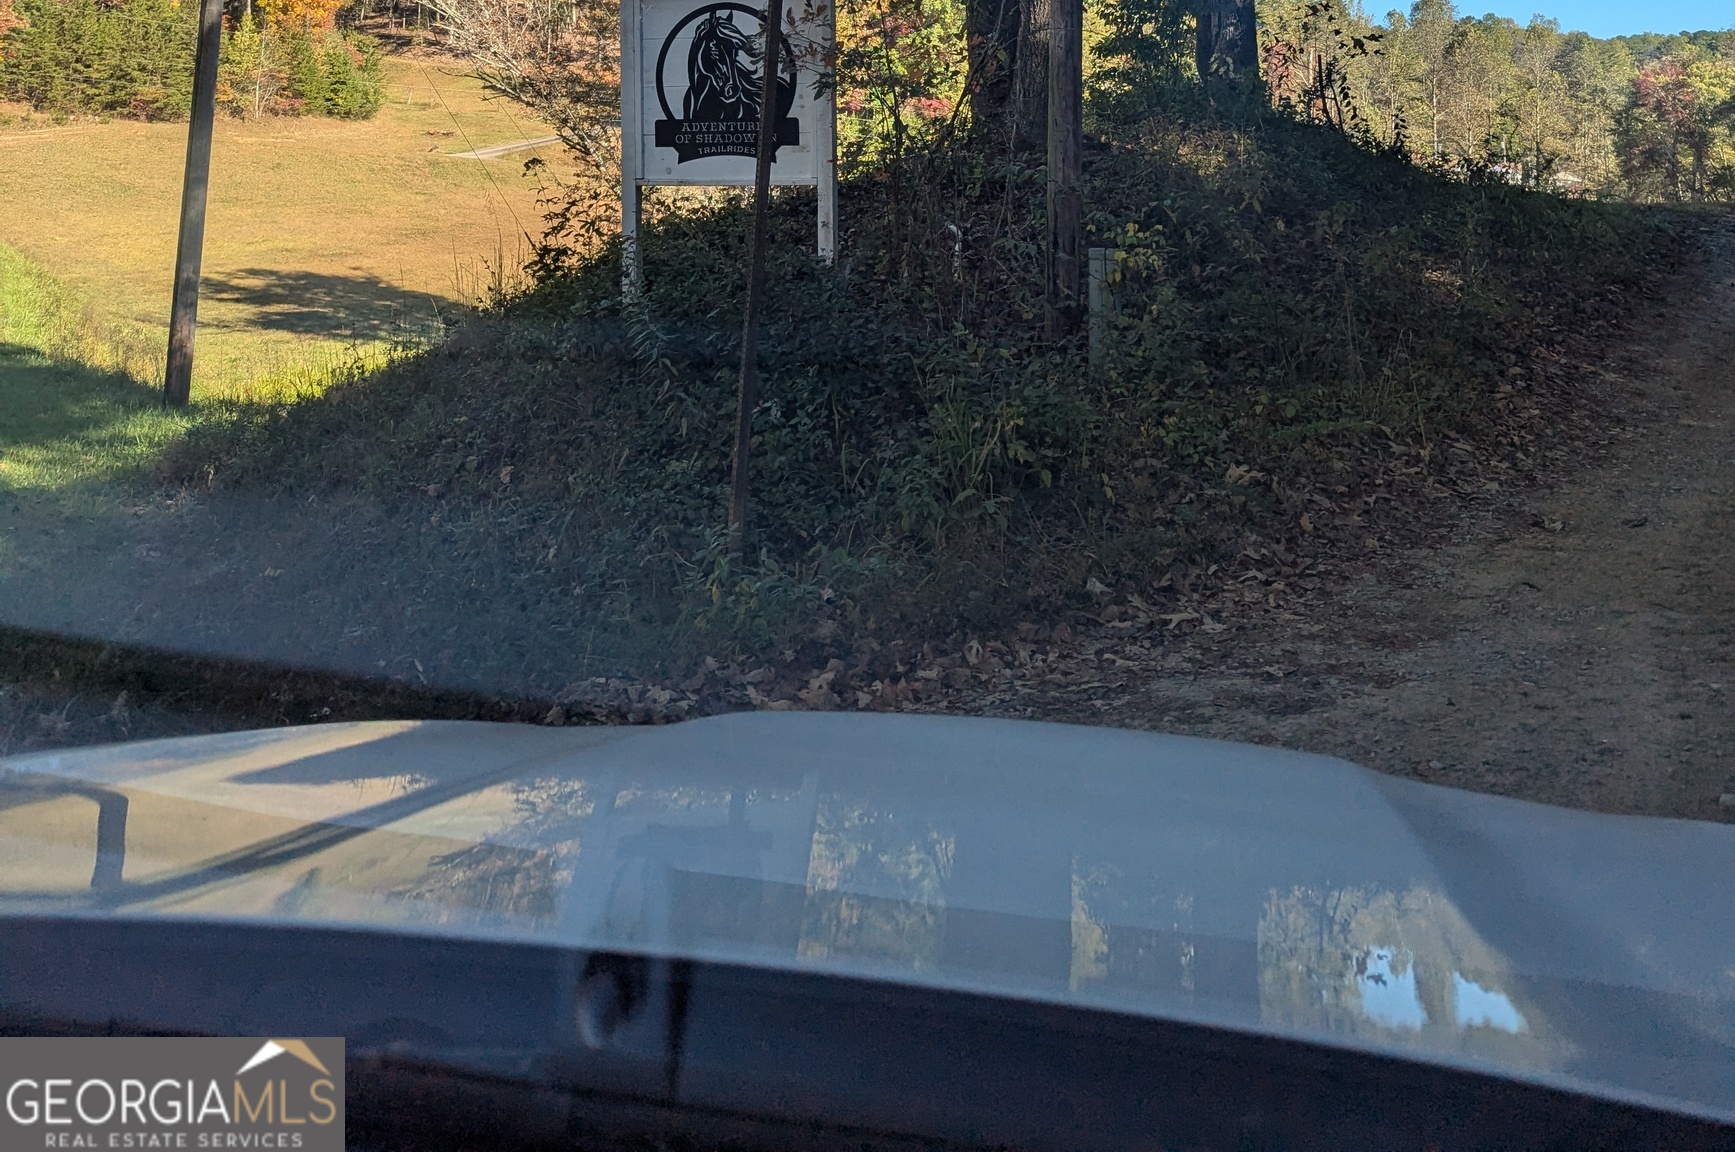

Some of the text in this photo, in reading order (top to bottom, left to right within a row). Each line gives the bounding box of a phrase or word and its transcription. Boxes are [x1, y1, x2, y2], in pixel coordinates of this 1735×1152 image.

[681, 121, 761, 132] ADVENTUR
[675, 134, 692, 144] OF
[695, 133, 757, 144] SHADOW
[698, 145, 756, 155] TRAILRIDES
